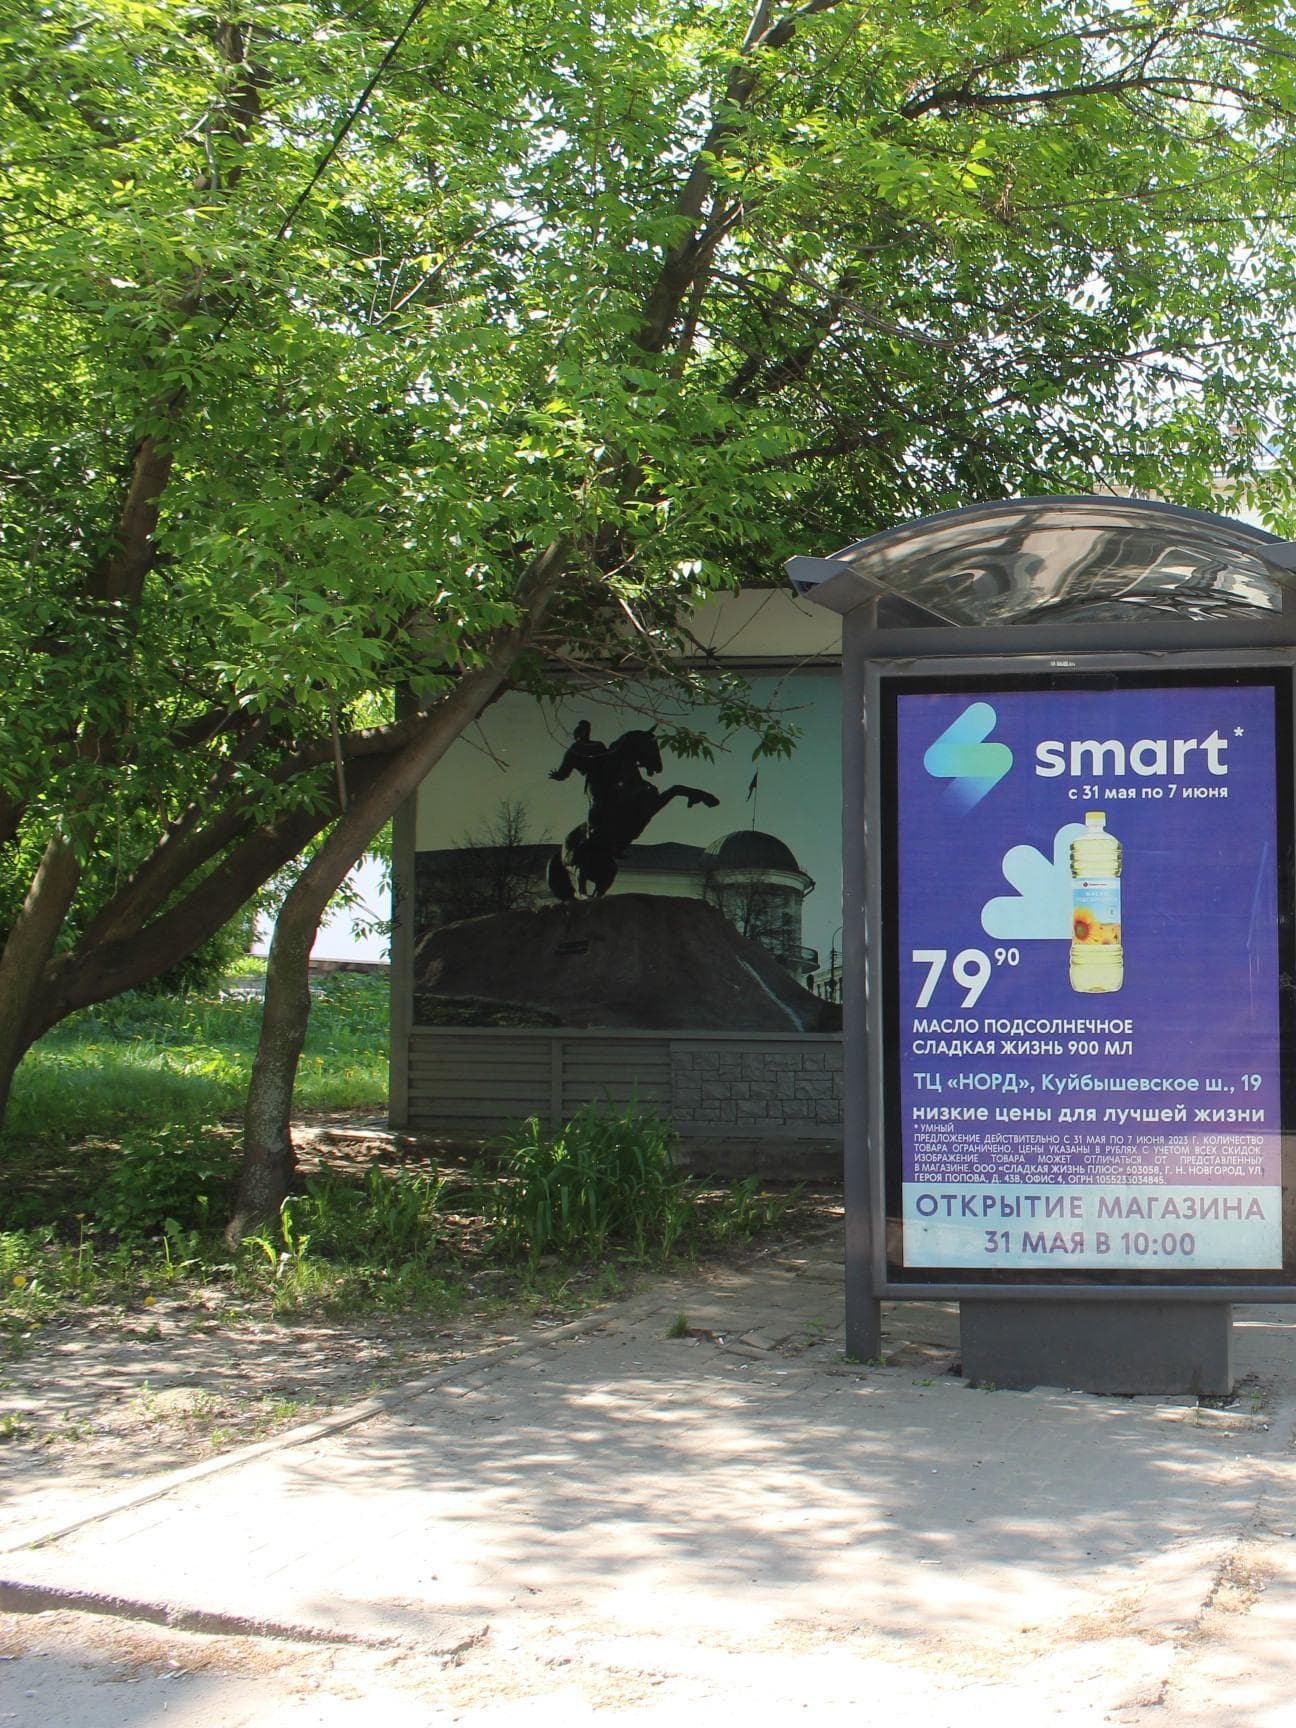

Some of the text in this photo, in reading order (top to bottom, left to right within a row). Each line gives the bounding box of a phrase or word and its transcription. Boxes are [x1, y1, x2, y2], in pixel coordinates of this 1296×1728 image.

[1068, 785, 1229, 799] с 31 мая по 7 июня
[912, 1019, 1133, 1036] МАСЛО ПОДСОЛНЕЧНОЕ
[912, 1040, 1133, 1057] СЛАДКАЯ ЖИЗНЬ 900 МЛ
[913, 1072, 1262, 1096] ТЦ «НОРД», Куйбышевское ш., 19
[912, 1104, 1265, 1125] низкие цены для лучшей жизни
[920, 1123, 954, 1133] УМНЫЙ
[914, 1133, 1264, 1145] ПРЕДЛОЖЕНИЕ ДЕЙСТВИТЕЛЬНО С 31 МАЯ ПО 7 ИЮНЯ 2023 Г. КОЛИЧЕСТВО
[914, 1144, 948, 1152] ТОВАРА
[952, 1144, 1014, 1153] ОГРАНИЧЕНО.
[1018, 1145, 1044, 1154] ЦЕНЫ
[1049, 1145, 1090, 1154] УКАЗАНЫ
[1095, 1145, 1100, 1153] В
[1105, 1146, 1137, 1154] РУБЛЯХ
[1142, 1146, 1148, 1154] С
[1153, 1146, 1190, 1155] УЧЕТОМ
[1195, 1146, 1216, 1155] ВСЕХ
[914, 1154, 1264, 1166] ИЗОБРАЖЕНИЕ ТОВАРА МОЖЕТ ОТЛИЧАТЬСЯ ОТ ПРЕДСТАВЛЕННЫХ
[914, 1164, 920, 1172] В
[973, 1165, 996, 1173] ООО
[999, 1165, 1049, 1174] «СЛАДКАЯ
[1051, 1165, 1086, 1174] ЖИЗНЬ
[914, 1173, 943, 1182] ГЕРОЯ
[1026, 1174, 1055, 1184] ОФИС
[1068, 1175, 1093, 1184] ОГРН
[915, 1193, 1265, 1220] ОТКРЫТИЕ МАГАЗИНА
[984, 1230, 1195, 1256] 31 МАЯ В 10:00
